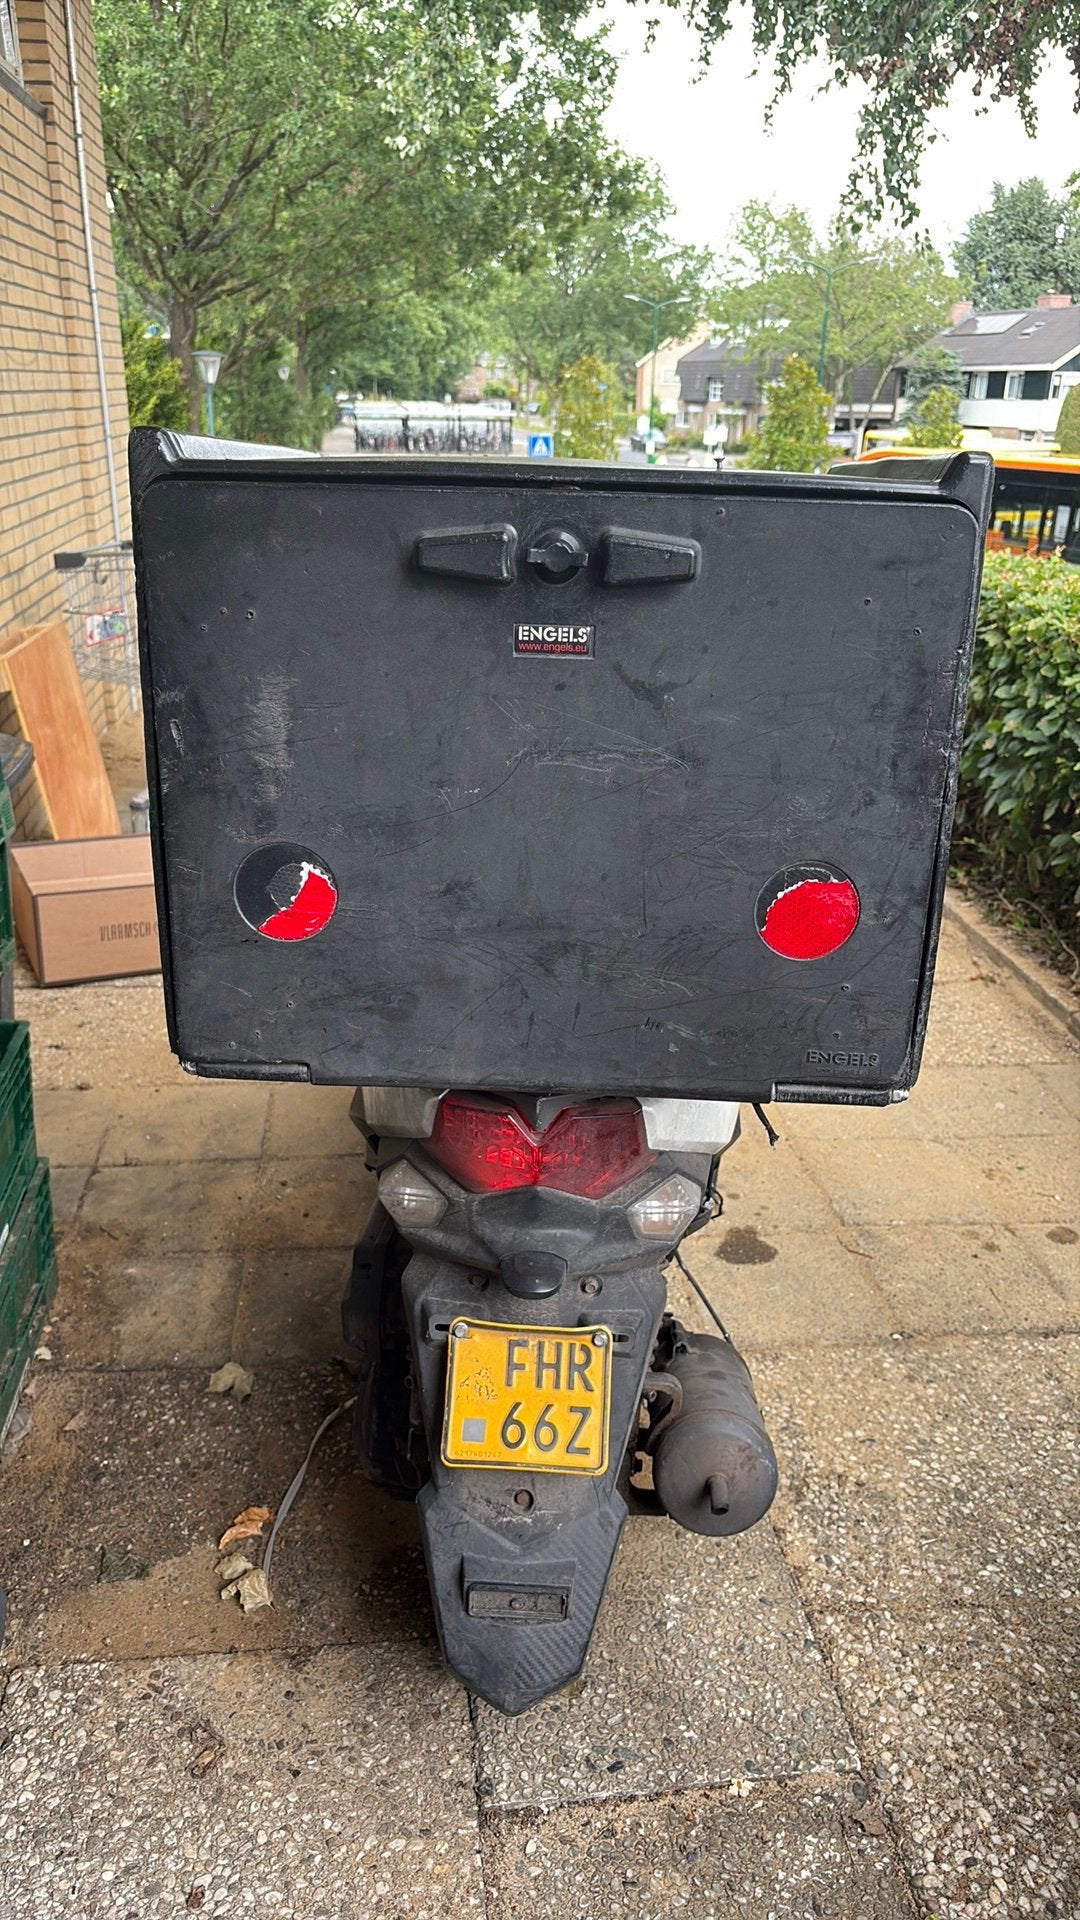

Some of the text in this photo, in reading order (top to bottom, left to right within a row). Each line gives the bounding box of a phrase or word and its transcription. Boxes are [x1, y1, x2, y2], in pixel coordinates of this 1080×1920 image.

[518, 642, 587, 653] www.engels.eu
[100, 920, 152, 942] VLAAMSCH
[807, 1050, 879, 1067] ENGELS
[505, 1338, 595, 1392] FHR
[500, 1401, 592, 1456] 66Z
